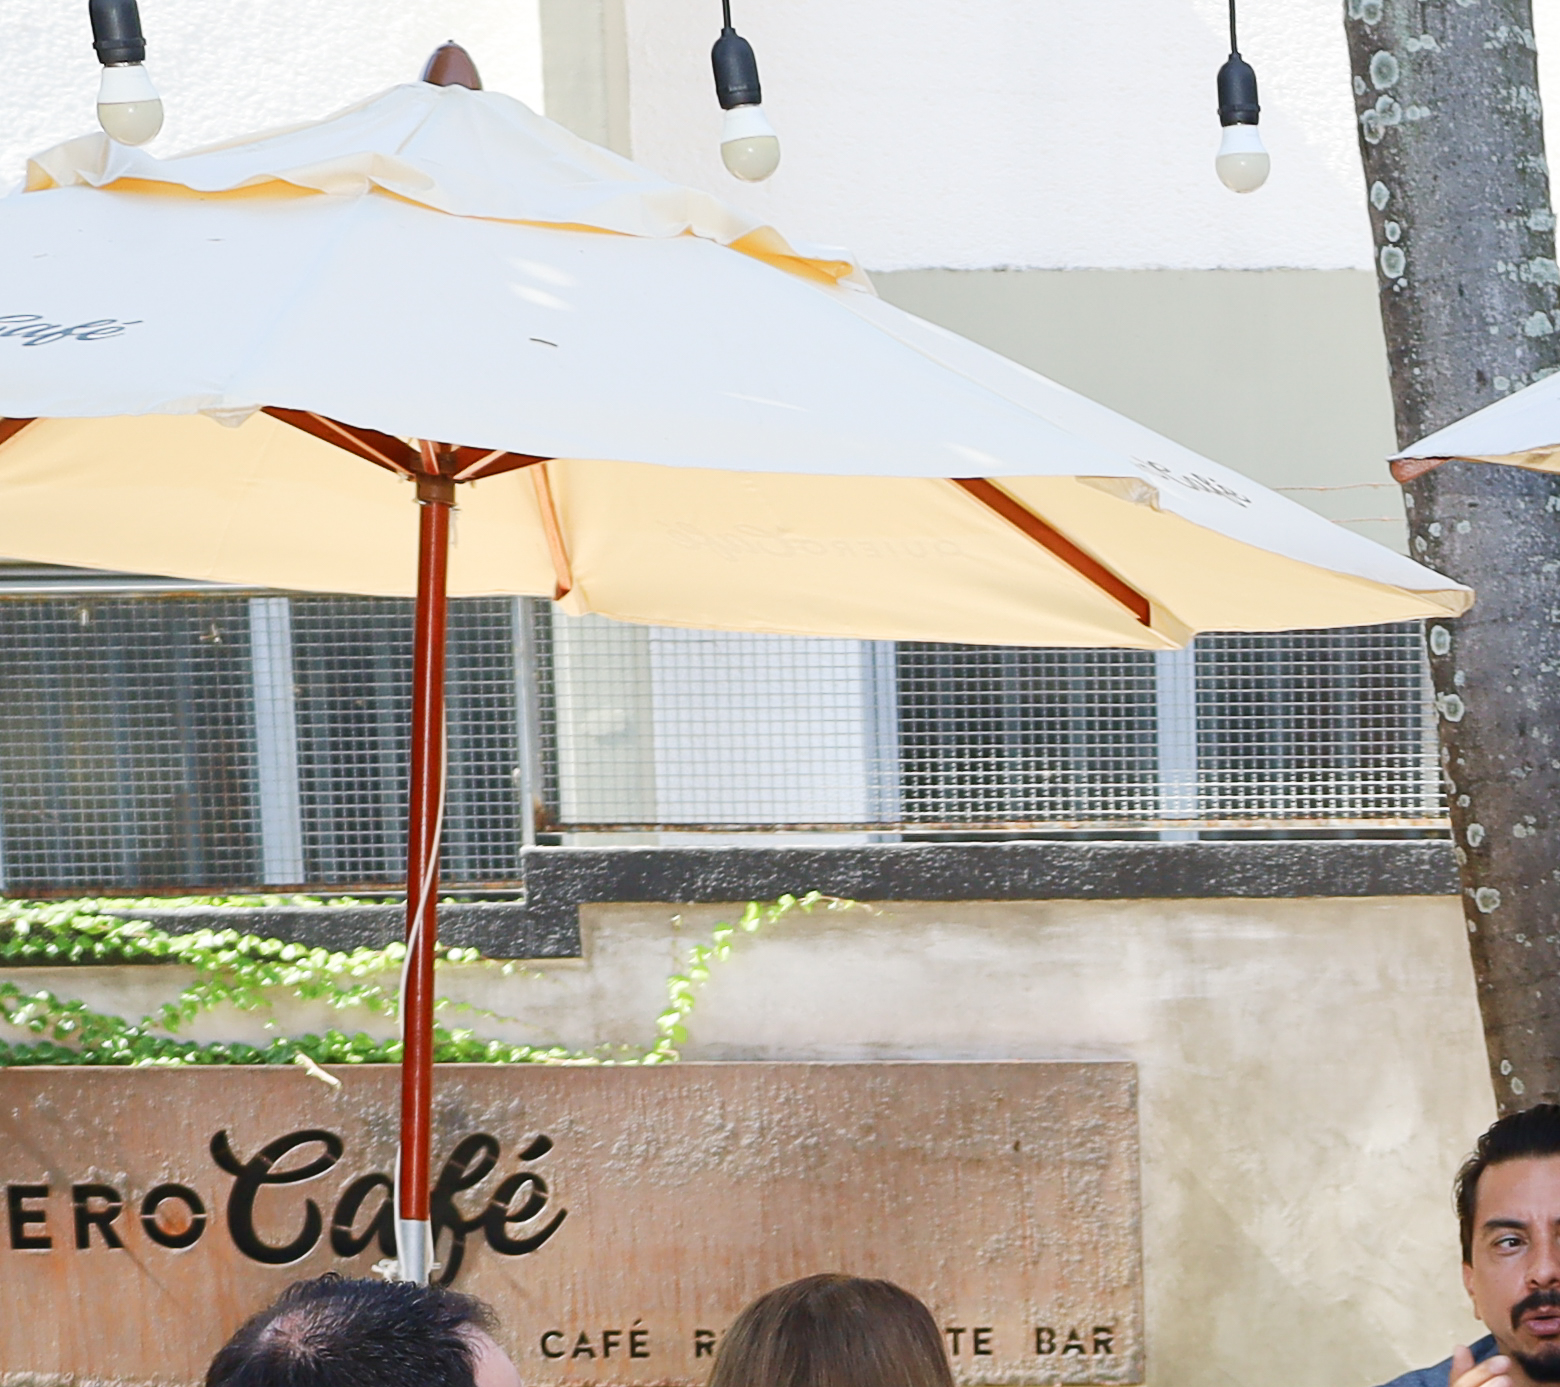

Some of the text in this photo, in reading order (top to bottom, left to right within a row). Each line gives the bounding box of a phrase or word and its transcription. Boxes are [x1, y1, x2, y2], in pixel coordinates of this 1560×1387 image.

[208, 1127, 568, 1287] Café
[540, 1319, 651, 1359] CAFÉ
[1035, 1326, 1114, 1357] BAR
